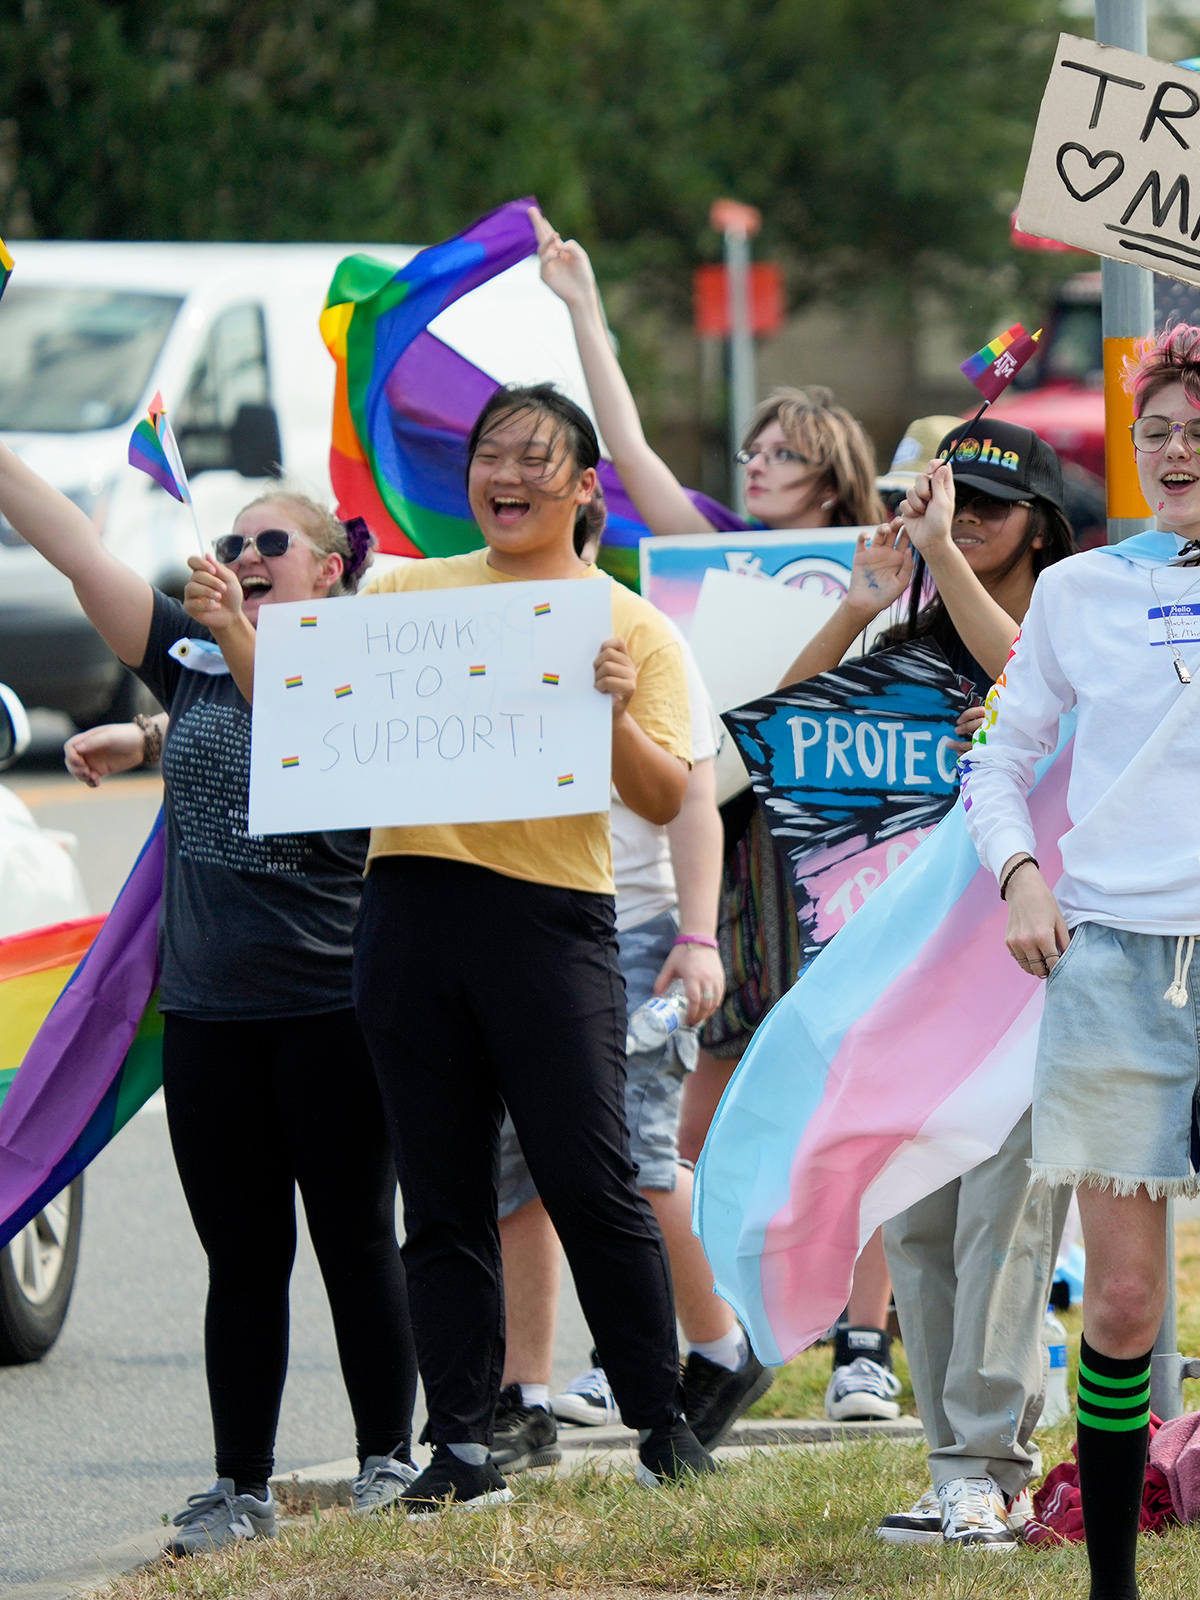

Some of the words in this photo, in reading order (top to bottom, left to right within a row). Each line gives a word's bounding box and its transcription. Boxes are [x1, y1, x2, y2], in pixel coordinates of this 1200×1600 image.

[365, 618, 475, 654] HONK
[375, 665, 443, 699] TO
[320, 712, 544, 772] SUPPORT!
[787, 715, 958, 785] PROTEC
[228, 809, 249, 821] READ
[267, 861, 298, 871] BOOKS
